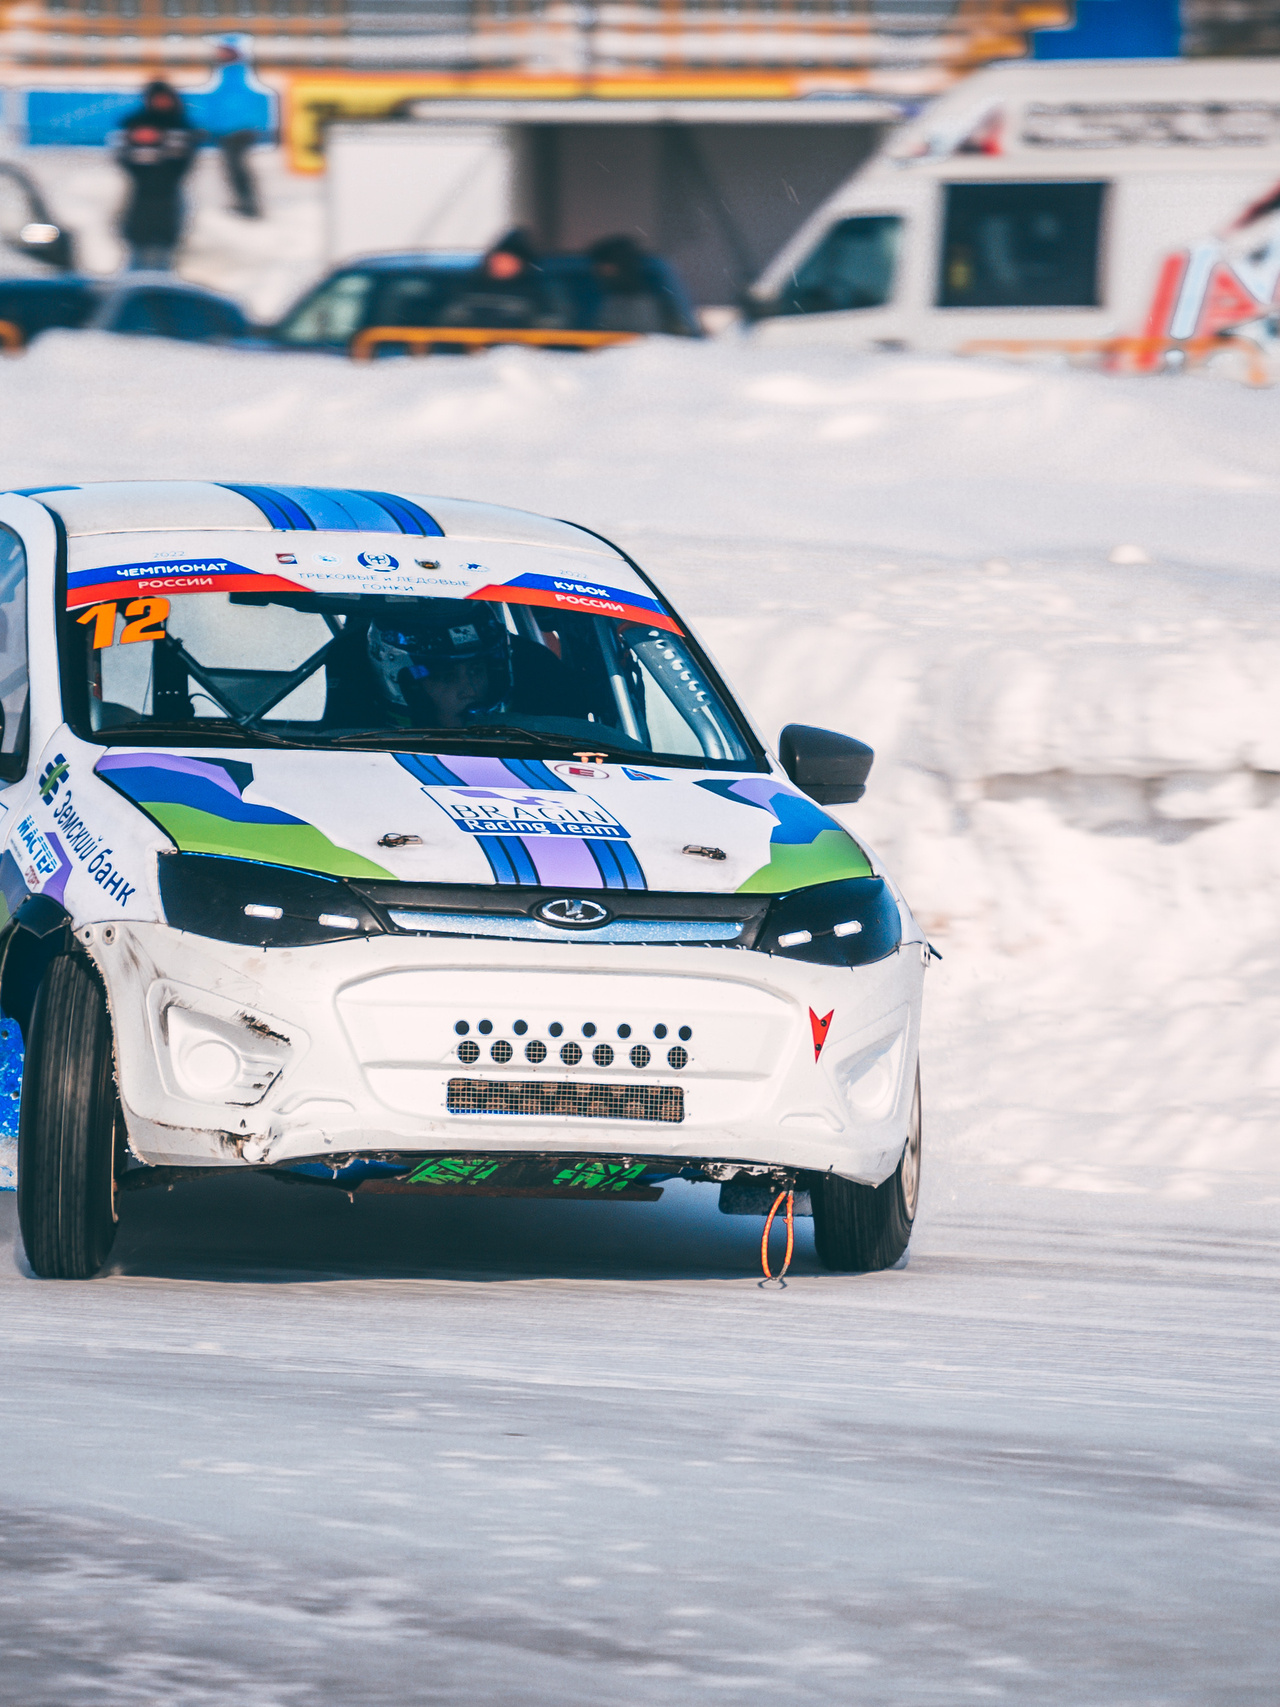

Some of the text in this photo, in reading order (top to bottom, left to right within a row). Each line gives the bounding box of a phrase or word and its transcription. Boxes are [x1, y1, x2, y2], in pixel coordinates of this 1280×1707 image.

[152, 551, 186, 559] 2022
[116, 562, 228, 577] ЧЕМПИОНАТ
[137, 577, 214, 590] РОССИИ
[297, 572, 380, 582] ТРЕКОВЫЕ
[396, 576, 471, 587] ЛЕДОВЫЕ
[361, 583, 415, 593] ГОНКИ
[553, 580, 611, 598] КУБОК
[554, 593, 625, 613] РОССИИ
[76, 597, 171, 650] 12
[450, 804, 610, 825] BRAGIN
[463, 819, 621, 836] Racing Team
[16, 814, 58, 874] МАСТЕР
[53, 790, 136, 907] Земский банк
